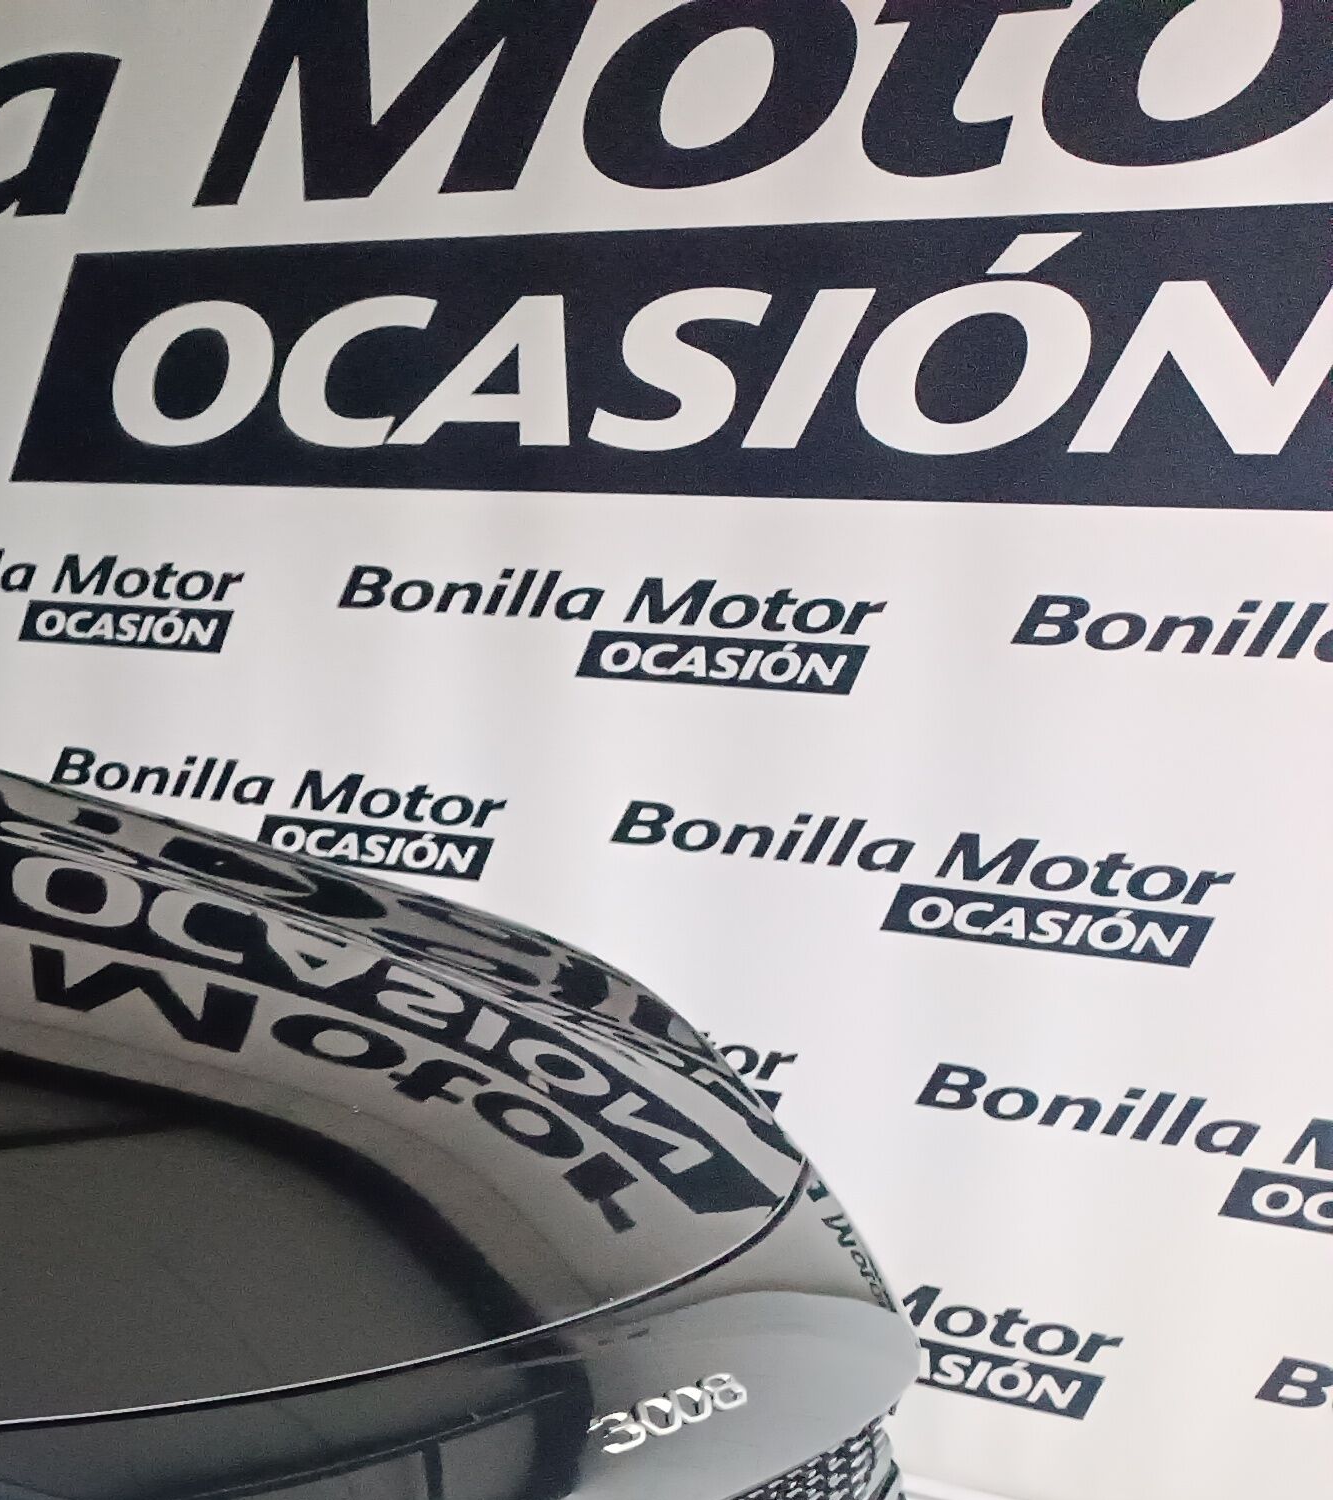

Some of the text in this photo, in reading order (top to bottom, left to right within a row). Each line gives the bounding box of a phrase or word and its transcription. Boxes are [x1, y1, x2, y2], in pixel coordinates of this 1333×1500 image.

[112, 232, 1333, 456] OCASIÓN
[51, 553, 245, 602] Motor
[337, 564, 888, 636] Bonilla Motor
[35, 608, 219, 646] OCASIÓN
[599, 641, 848, 687] OCASIÓN
[47, 746, 508, 828] Bonilla Motor
[271, 825, 479, 875] OCASIÓN
[610, 800, 1237, 907] Bonilla Motor
[907, 895, 1191, 958] OCASIÓN
[915, 1062, 1261, 1157] Bonilla
[586, 1372, 748, 1454] 3008
